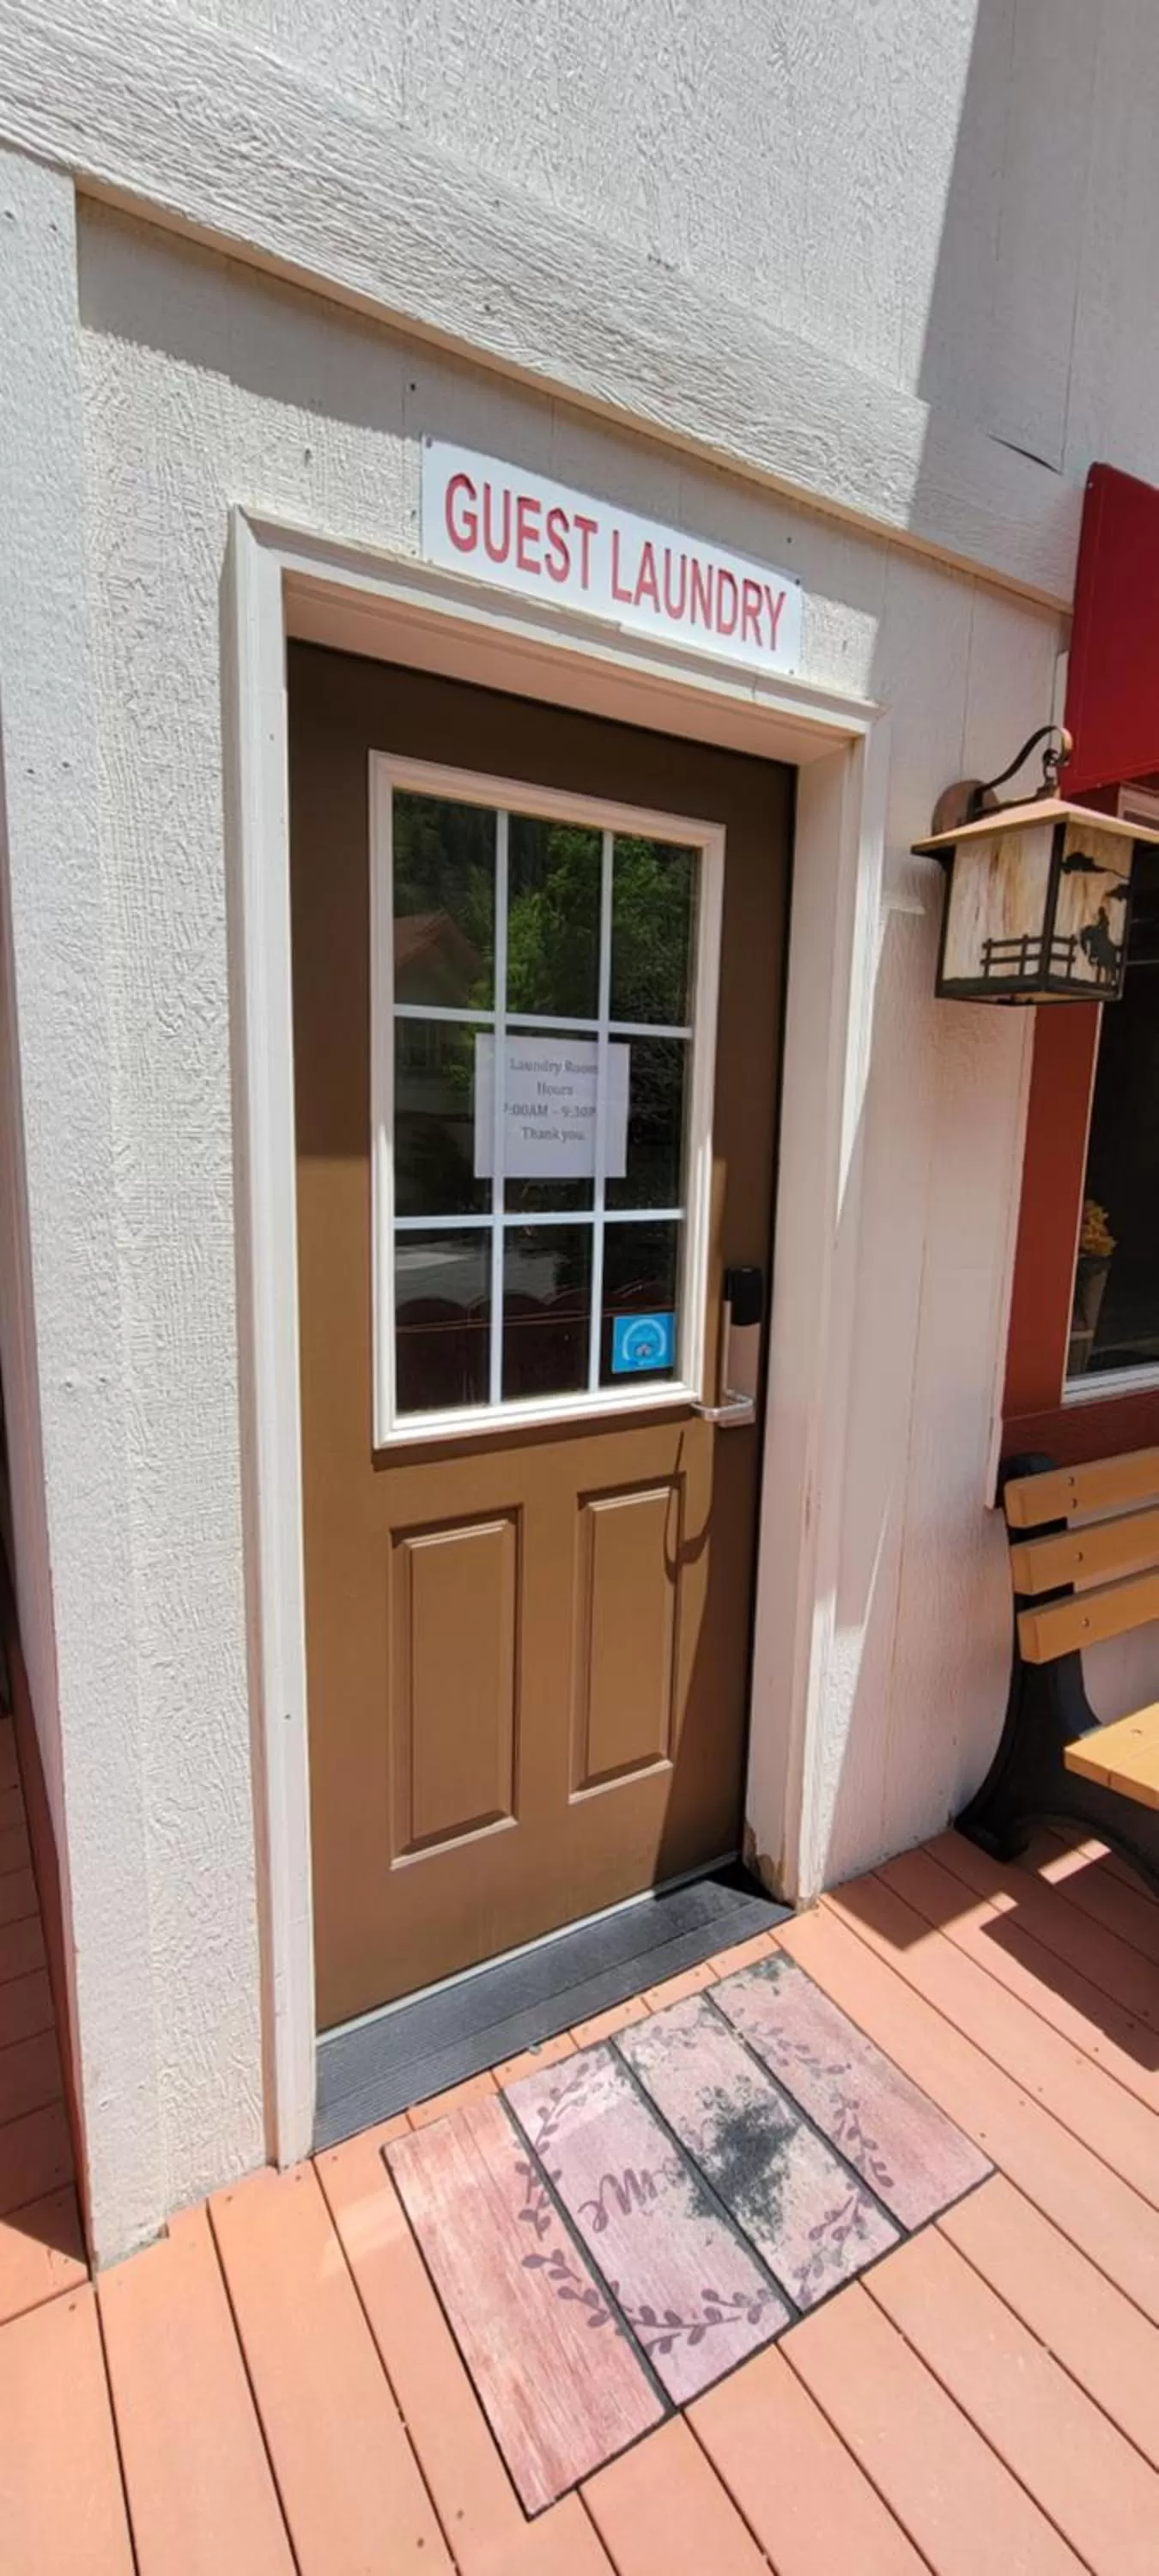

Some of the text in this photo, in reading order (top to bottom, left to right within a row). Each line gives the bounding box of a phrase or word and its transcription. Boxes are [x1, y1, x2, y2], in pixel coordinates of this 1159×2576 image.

[445, 473, 786, 650] GUEST LAUNDRY
[510, 1058, 562, 1076] Laundry
[537, 1082, 573, 1096] Hours
[561, 1104, 597, 1118] 9:30P
[522, 1127, 560, 1140] Thank
